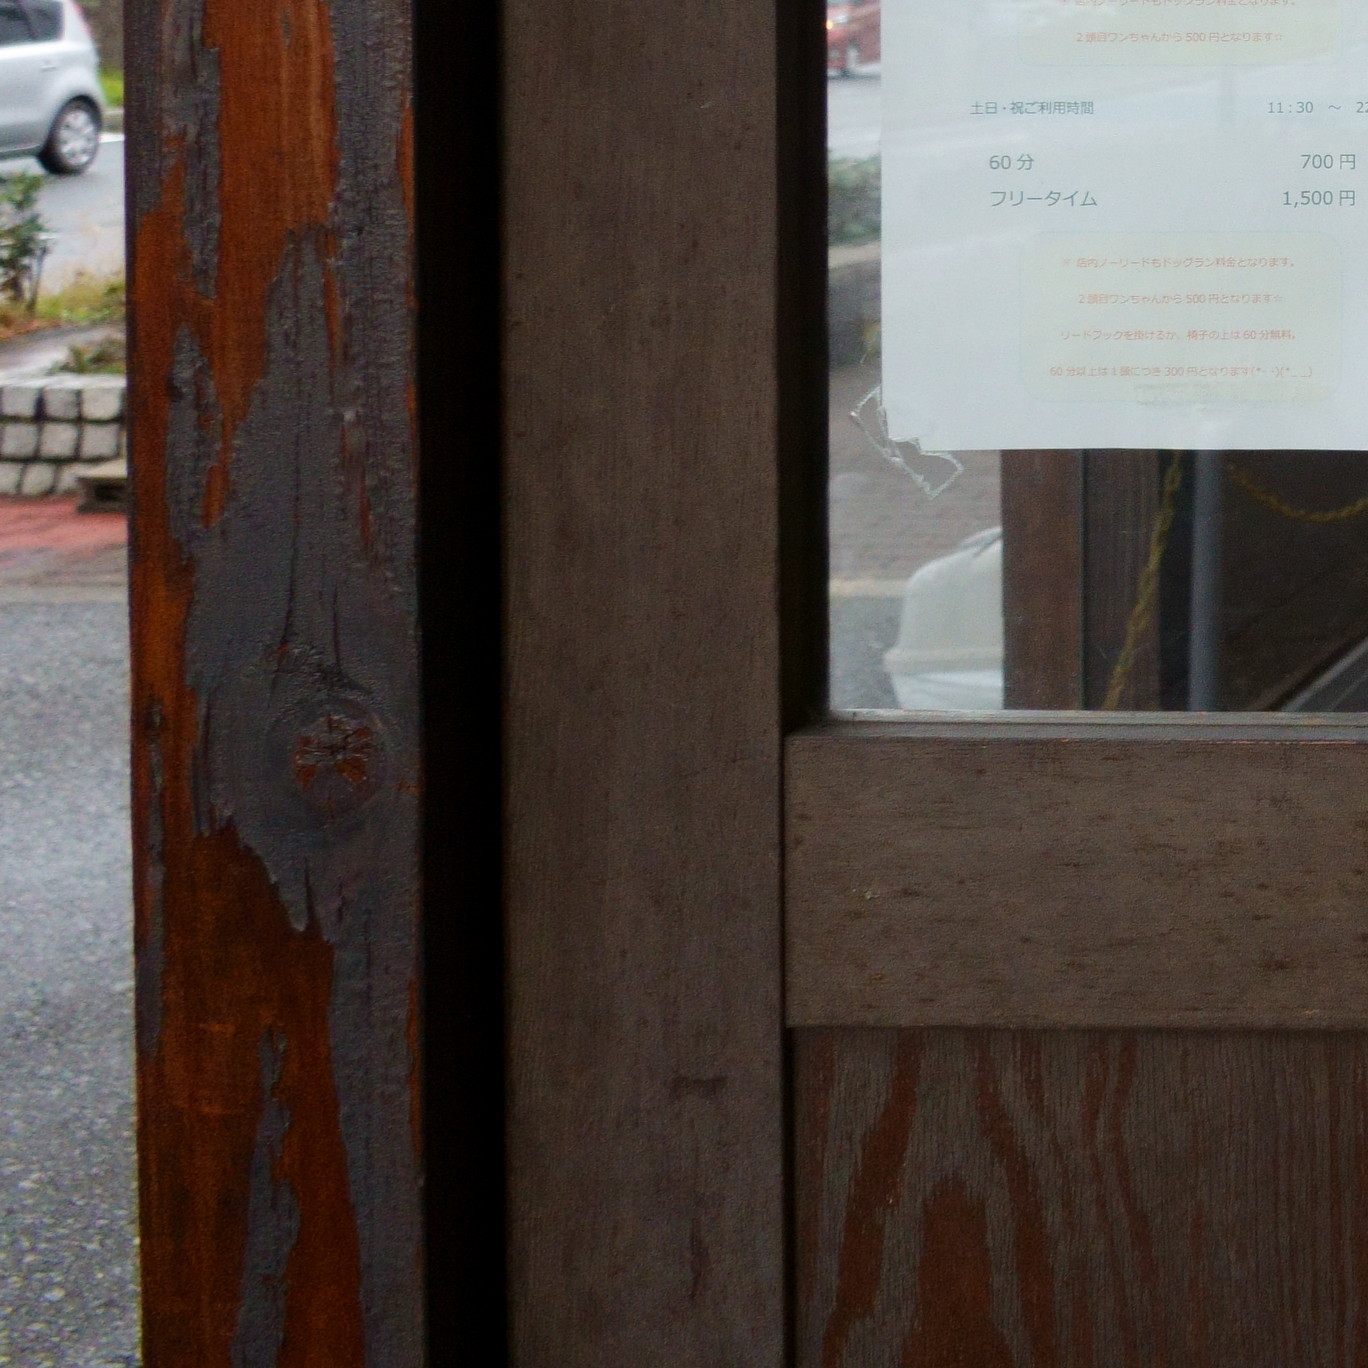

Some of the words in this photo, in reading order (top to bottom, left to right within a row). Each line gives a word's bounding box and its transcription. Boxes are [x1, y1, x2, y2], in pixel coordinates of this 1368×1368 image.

[969, 100, 1095, 116] 土日・祝ご利用時間
[989, 189, 1098, 208] フリータイム
